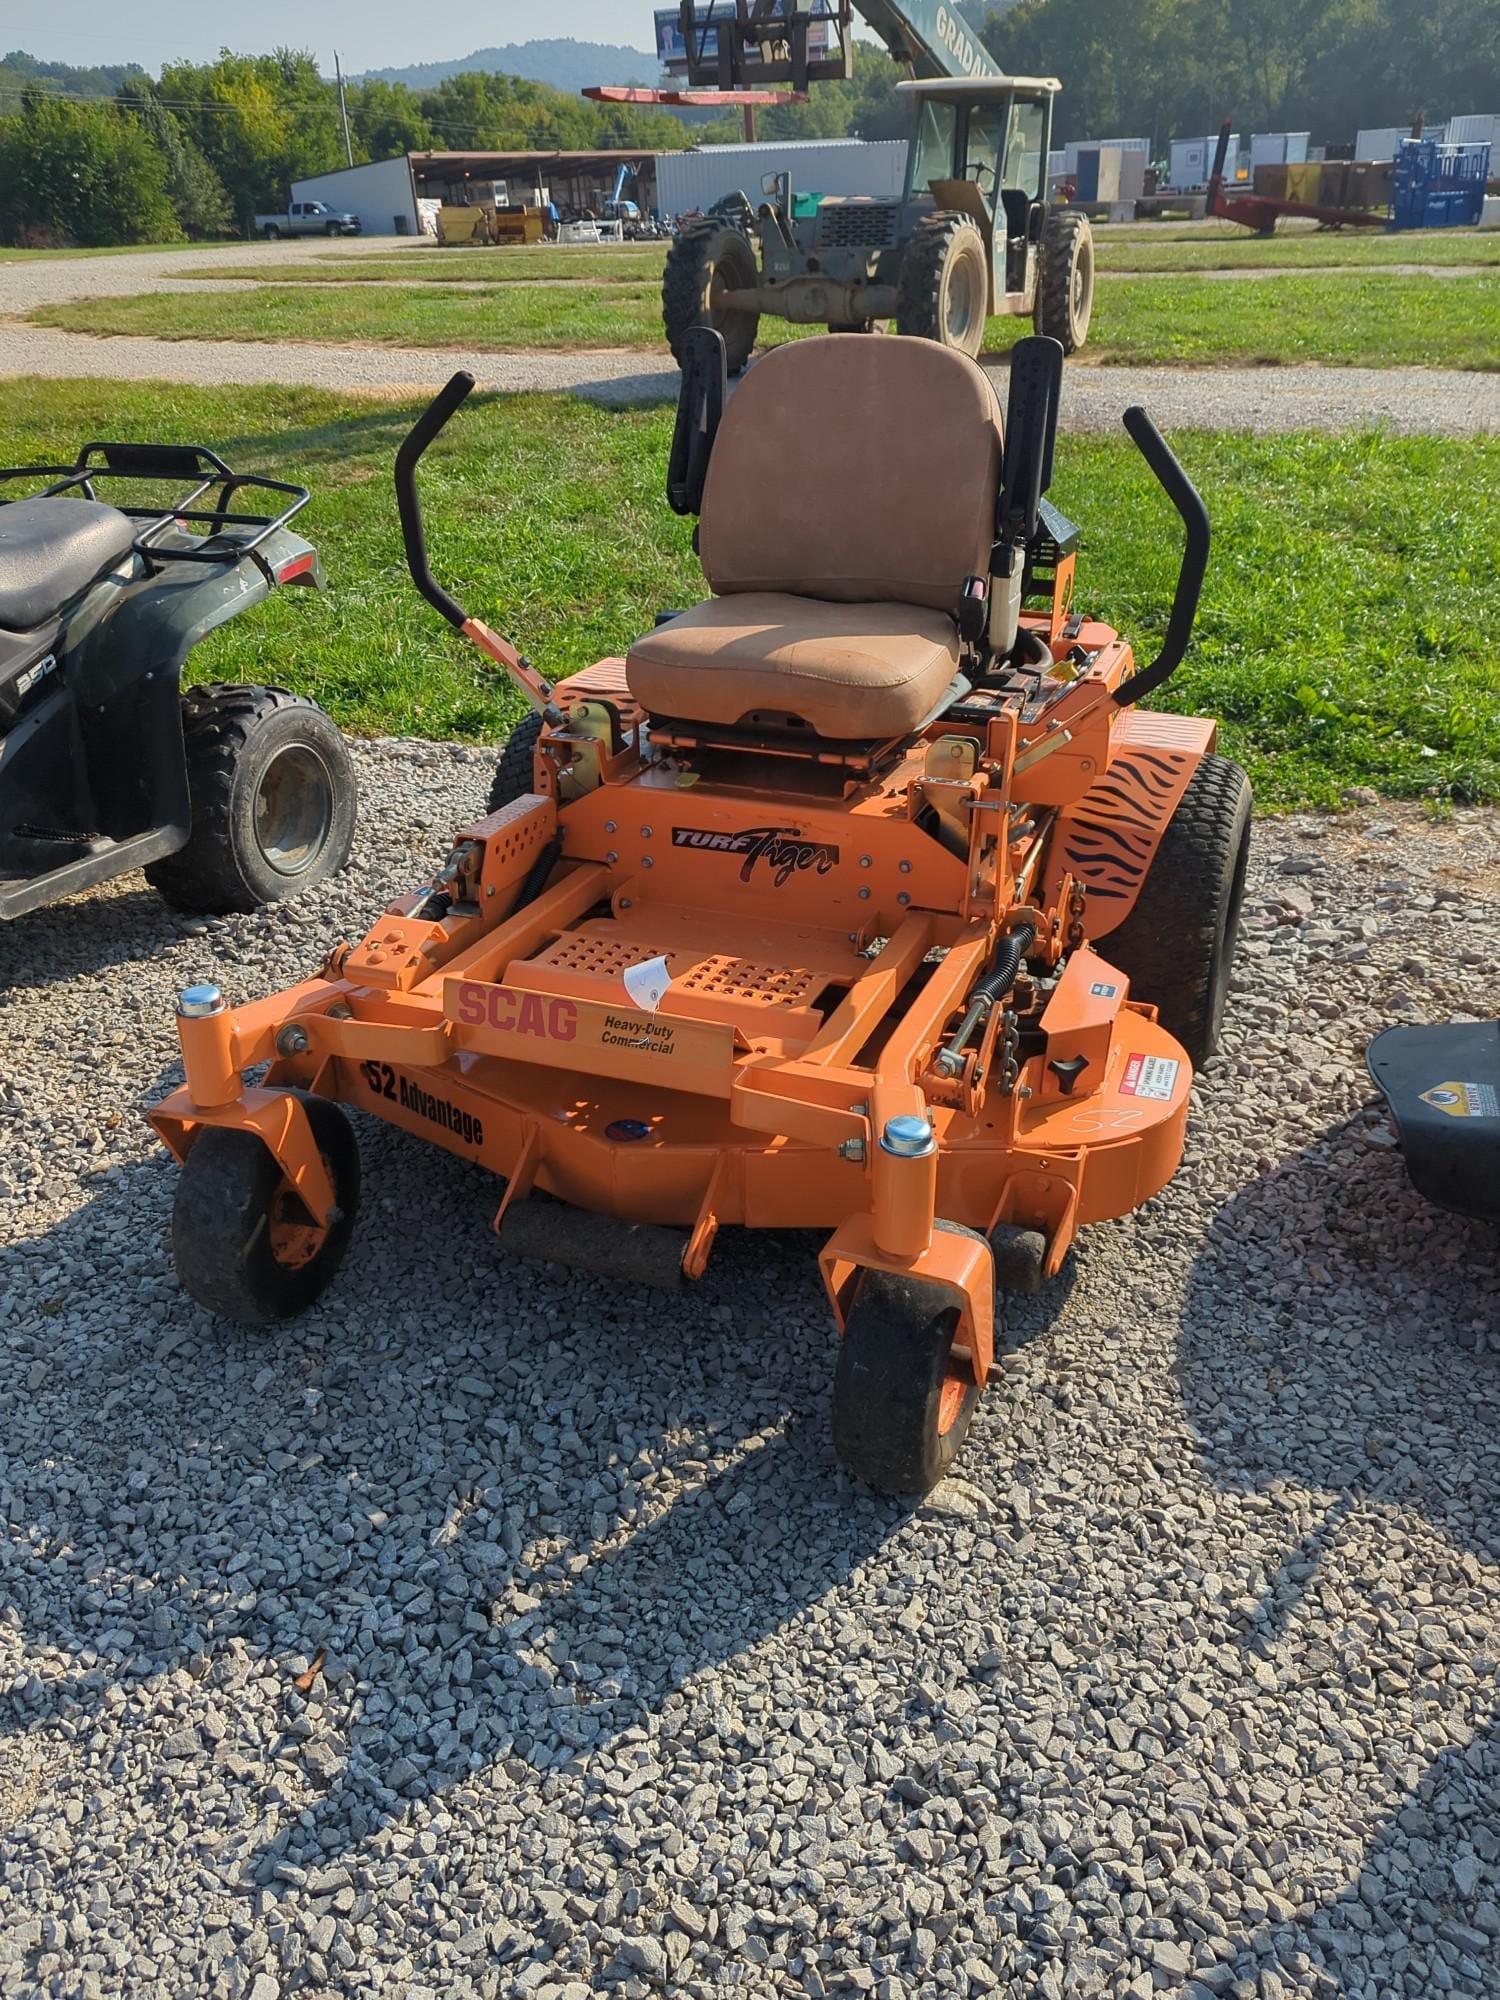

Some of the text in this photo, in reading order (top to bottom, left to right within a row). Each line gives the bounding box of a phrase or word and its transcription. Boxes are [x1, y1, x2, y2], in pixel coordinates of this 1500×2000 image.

[936, 5, 993, 79] GRADAL
[16, 653, 57, 697] 250
[674, 827, 834, 888] TURF Tiger
[458, 983, 578, 1042] SCAG
[604, 1015, 674, 1041] Heavy-Duty
[601, 1031, 675, 1055] Commercial
[399, 1075, 484, 1146] Advantage
